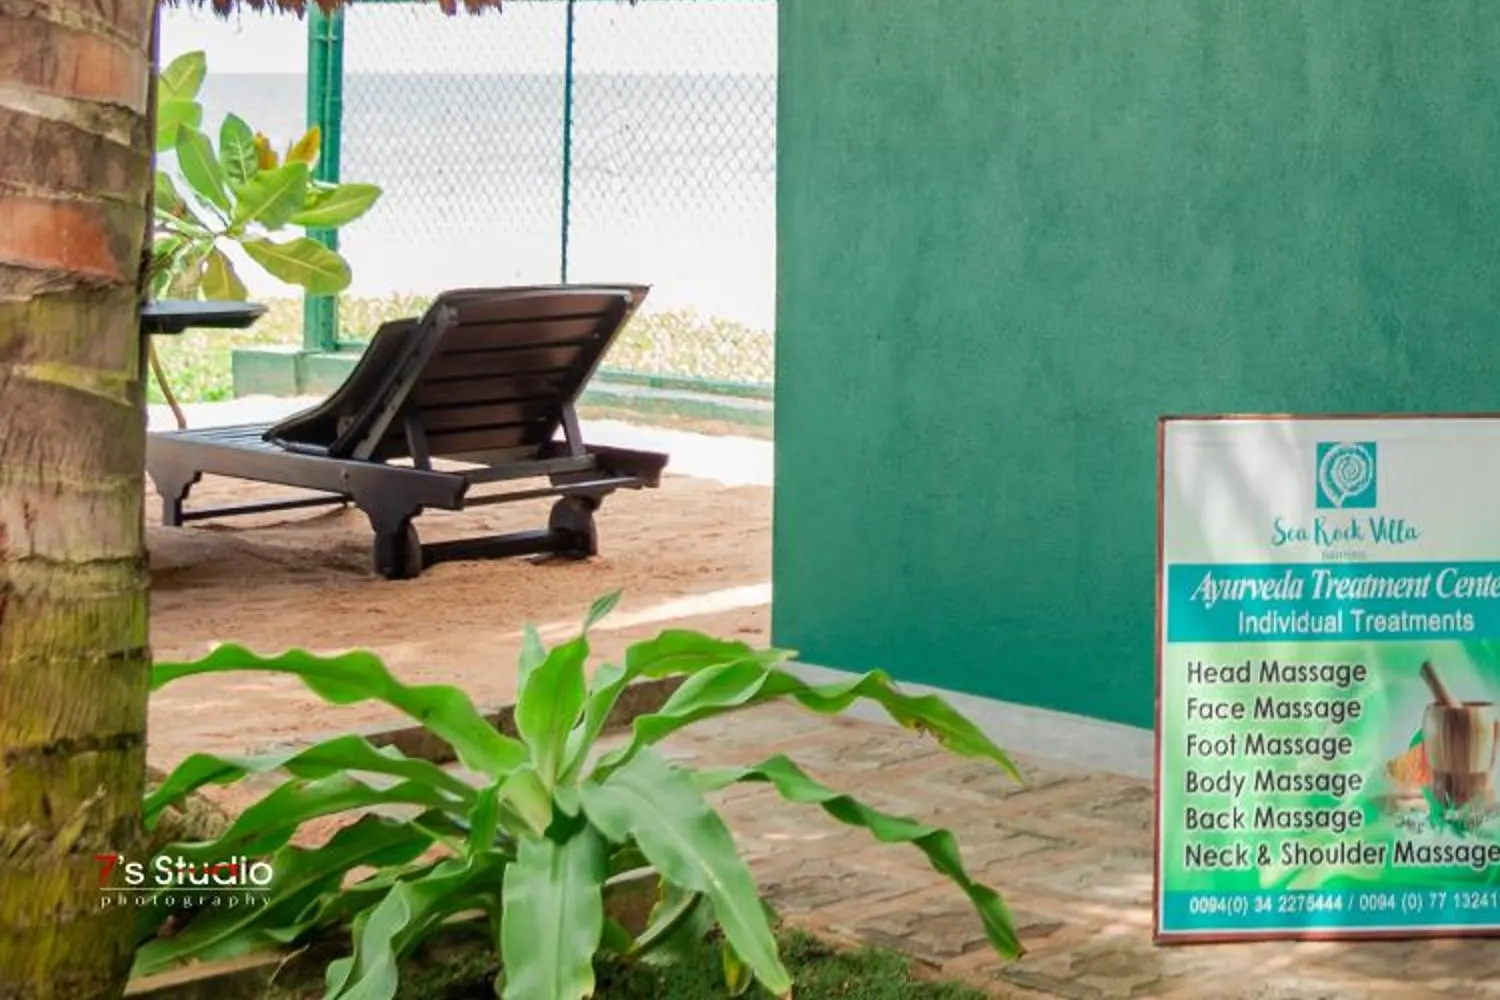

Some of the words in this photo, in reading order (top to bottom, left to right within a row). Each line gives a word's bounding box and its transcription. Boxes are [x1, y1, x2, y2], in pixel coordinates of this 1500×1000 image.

[1271, 517, 1308, 546] Sea
[1313, 515, 1364, 547] Rock
[1369, 516, 1421, 544] Villa
[1190, 568, 1304, 609] Ayurveda
[1311, 569, 1431, 600] Treatment
[1238, 608, 1343, 634] Individual
[1350, 608, 1474, 633] Treatments
[1187, 661, 1251, 683] Head
[1260, 662, 1367, 687] Massage
[1186, 698, 1245, 720] Face
[1254, 698, 1361, 723] Massage
[1186, 734, 1236, 757] Foot
[1245, 734, 1352, 760] Massage
[1186, 771, 1244, 797] Body
[1254, 771, 1362, 796] Massage
[1186, 807, 1245, 830] Back
[1254, 808, 1362, 832] Massage
[1185, 844, 1247, 867] Neck
[1257, 845, 1271, 866] &
[1282, 842, 1385, 865] Shoulder
[1359, 893, 1395, 911] 0094
[1401, 891, 1423, 914] (0)
[1429, 891, 1447, 909] 77
